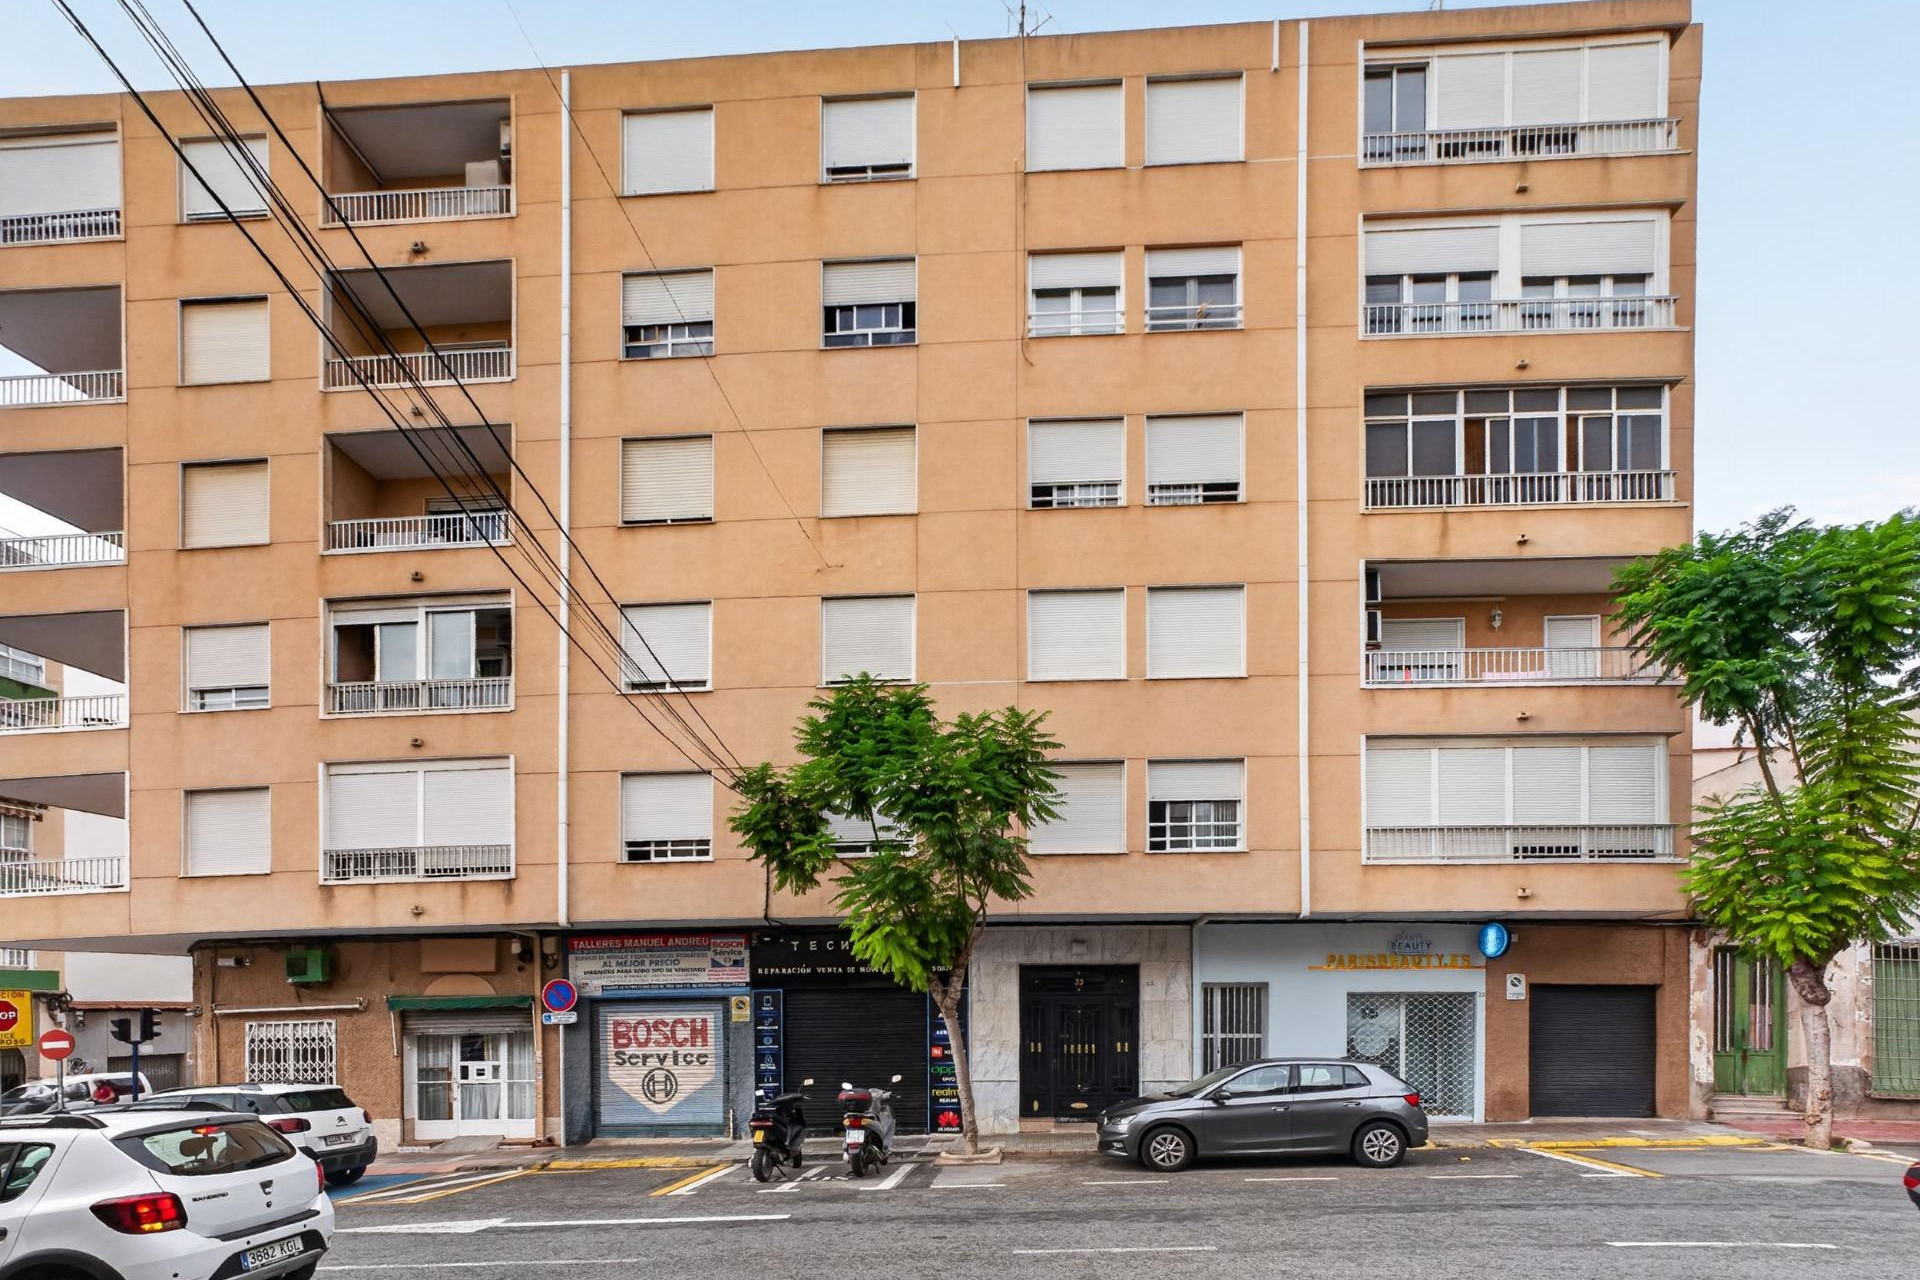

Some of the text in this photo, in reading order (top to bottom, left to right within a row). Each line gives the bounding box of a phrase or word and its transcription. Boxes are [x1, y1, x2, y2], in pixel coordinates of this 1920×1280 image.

[574, 937, 709, 949] TALLERES MANUEL ANDREU
[1391, 941, 1432, 950] BEAUTY
[602, 959, 680, 968] AL MEJOR PRECIO
[758, 964, 811, 974] REPARACIÓN
[0, 1011, 16, 1020] OP
[613, 1018, 708, 1049] BOSCH
[614, 1050, 708, 1066] Service
[931, 1066, 956, 1076] opp
[932, 1088, 959, 1097] realm
[249, 1239, 301, 1265] 3682 KGL
